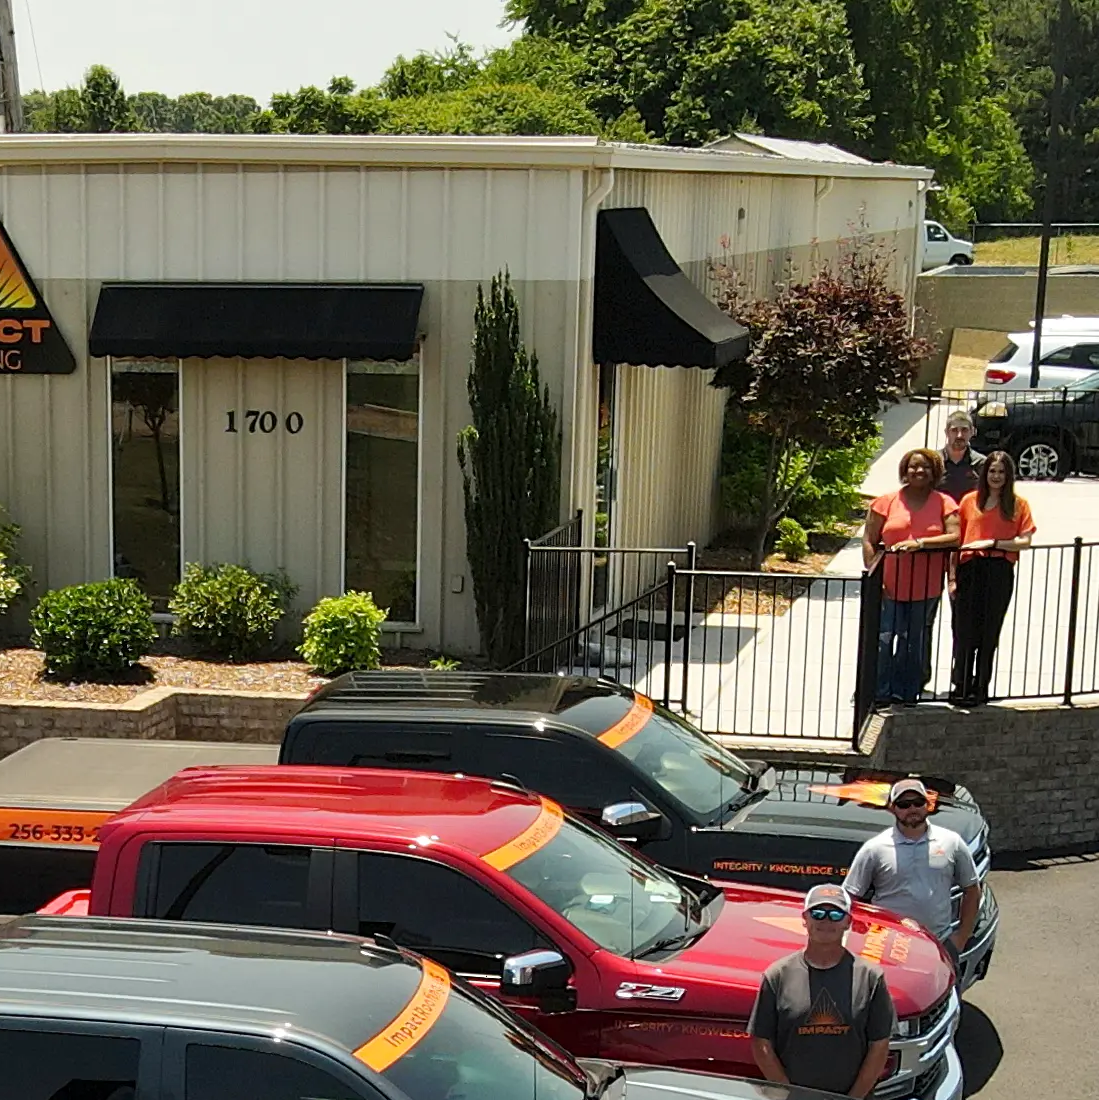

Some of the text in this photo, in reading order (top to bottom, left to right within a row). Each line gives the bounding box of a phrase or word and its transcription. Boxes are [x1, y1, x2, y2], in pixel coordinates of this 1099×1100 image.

[224, 411, 304, 434] 1700
[9, 823, 101, 843] 256-333-2
[713, 861, 762, 872] INTEGRITY
[769, 864, 833, 876] KNOWLEDGE
